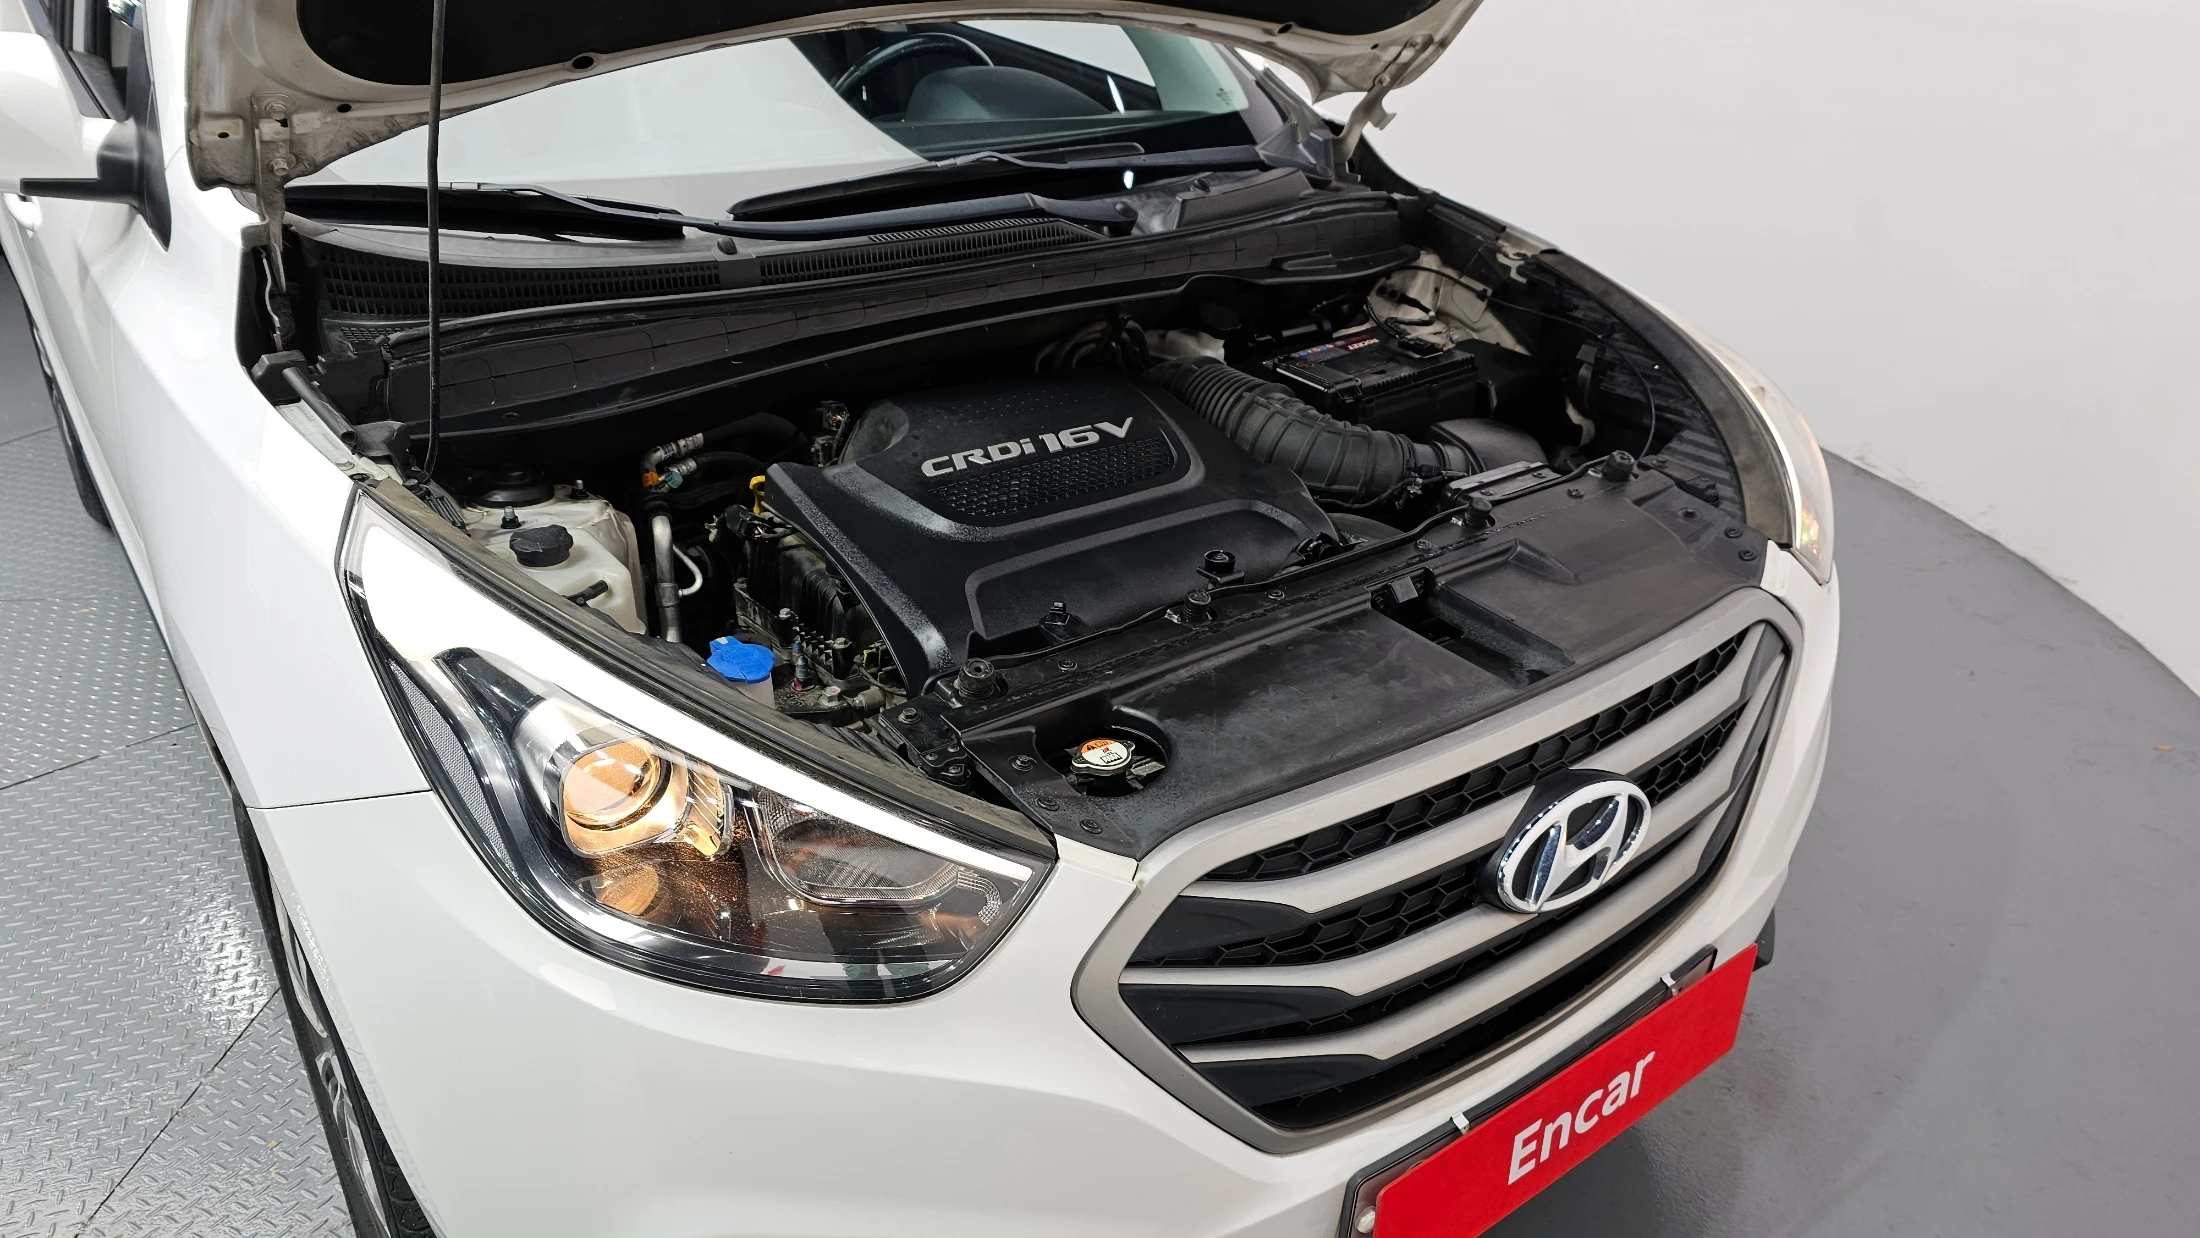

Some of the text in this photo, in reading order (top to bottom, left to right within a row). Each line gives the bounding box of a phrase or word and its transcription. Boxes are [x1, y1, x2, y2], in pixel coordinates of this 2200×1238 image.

[921, 416, 1134, 477] CRDi 16V
[1507, 1050, 1656, 1186] Encar
